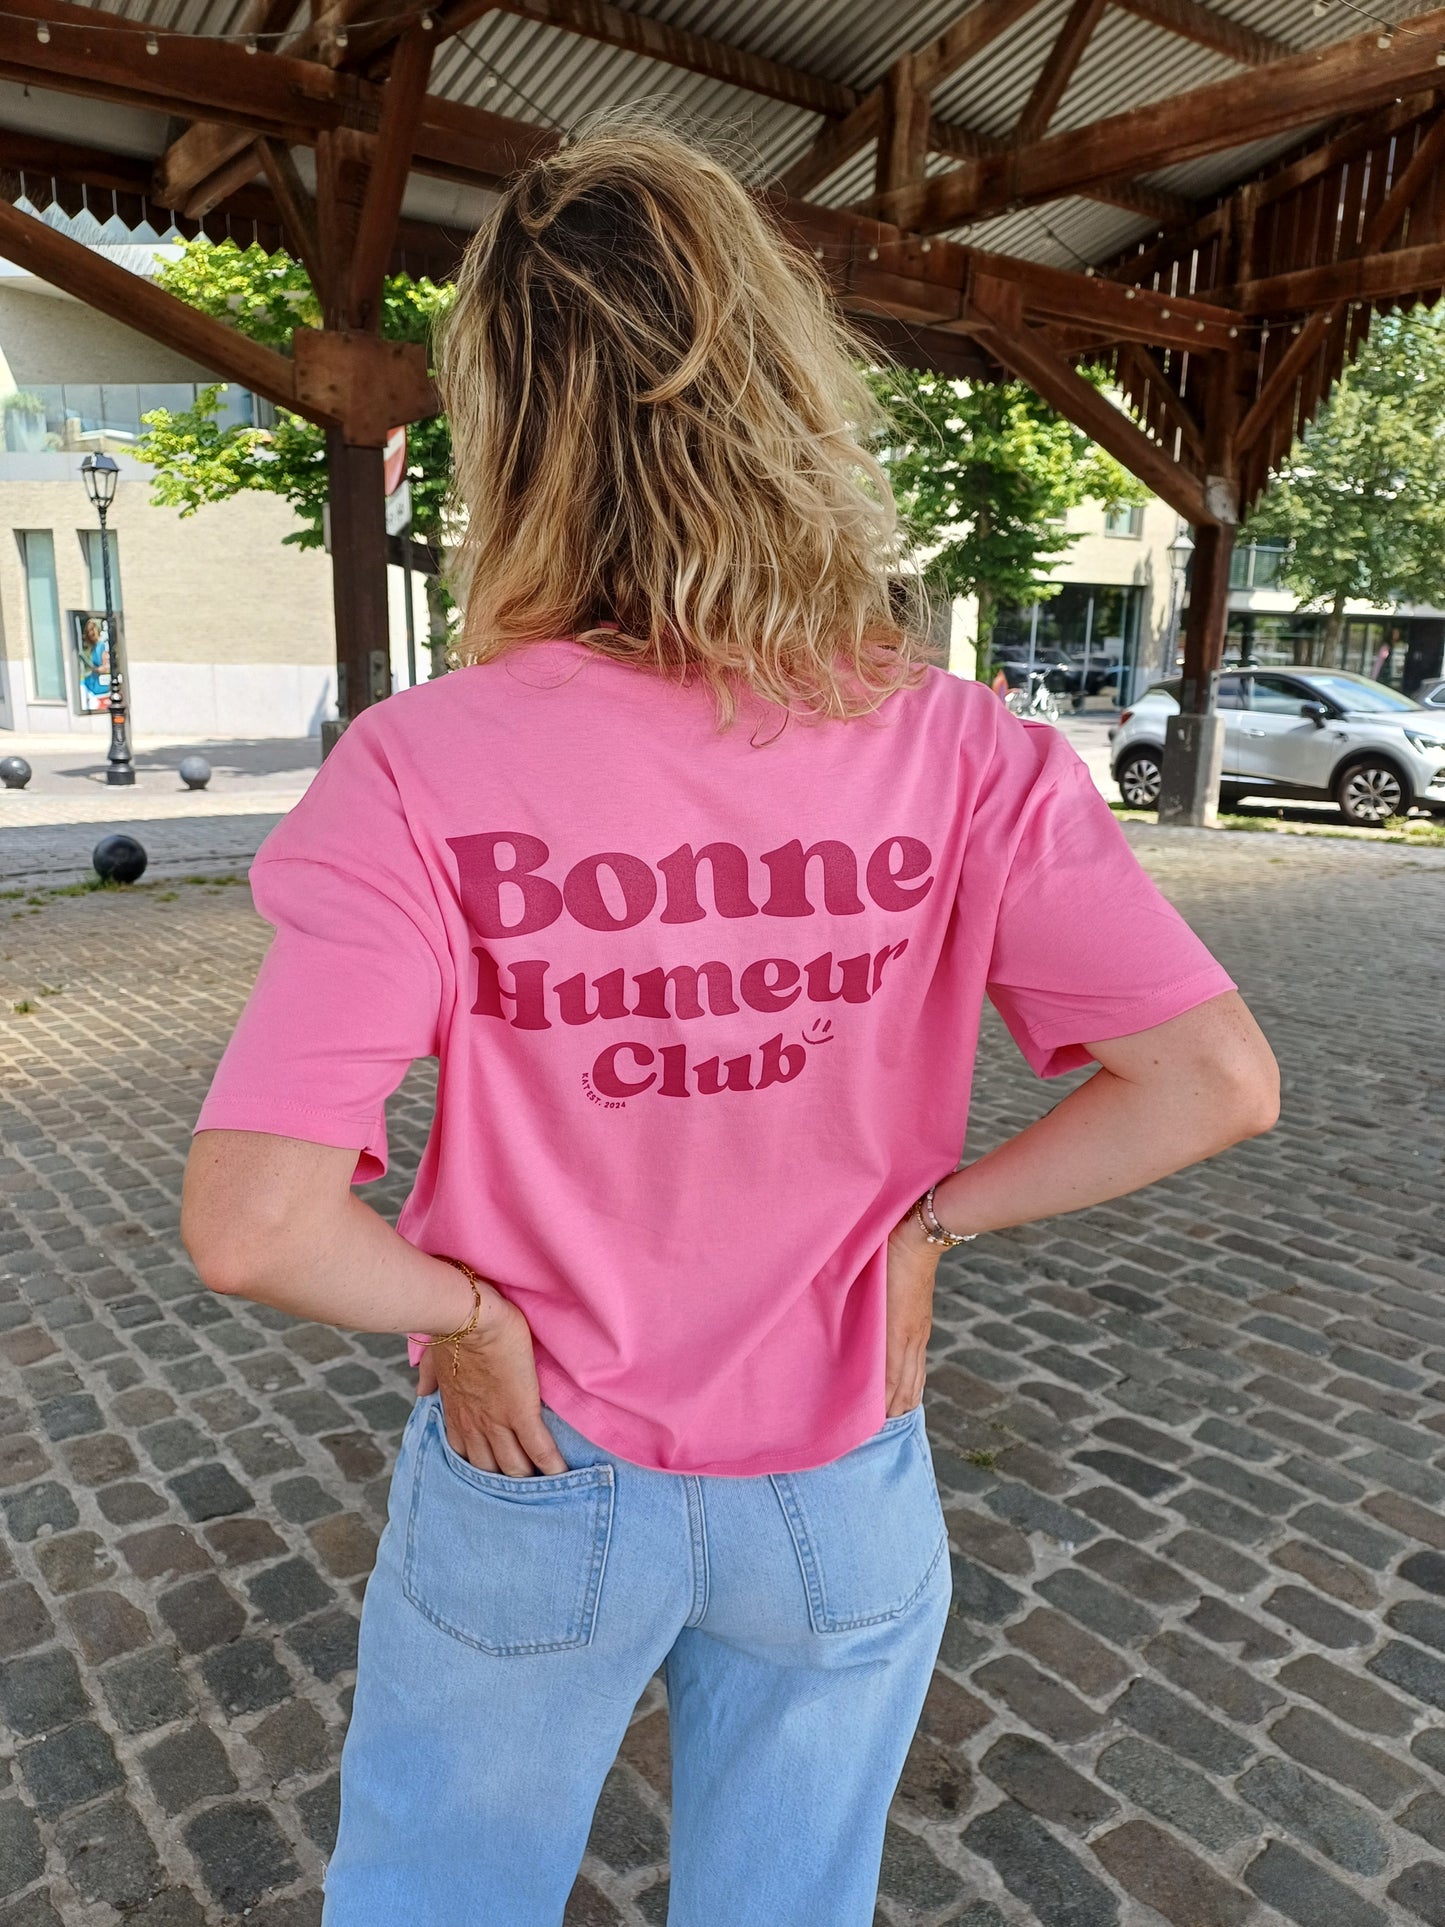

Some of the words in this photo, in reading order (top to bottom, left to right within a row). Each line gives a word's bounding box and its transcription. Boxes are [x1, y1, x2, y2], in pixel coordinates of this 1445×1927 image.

[445, 831, 934, 939] Bonne
[470, 938, 909, 1030] Humeur
[581, 1072, 591, 1090] KAT
[586, 1090, 602, 1106] EST.
[604, 1101, 626, 1109] 2024
[592, 1033, 807, 1098] Club
